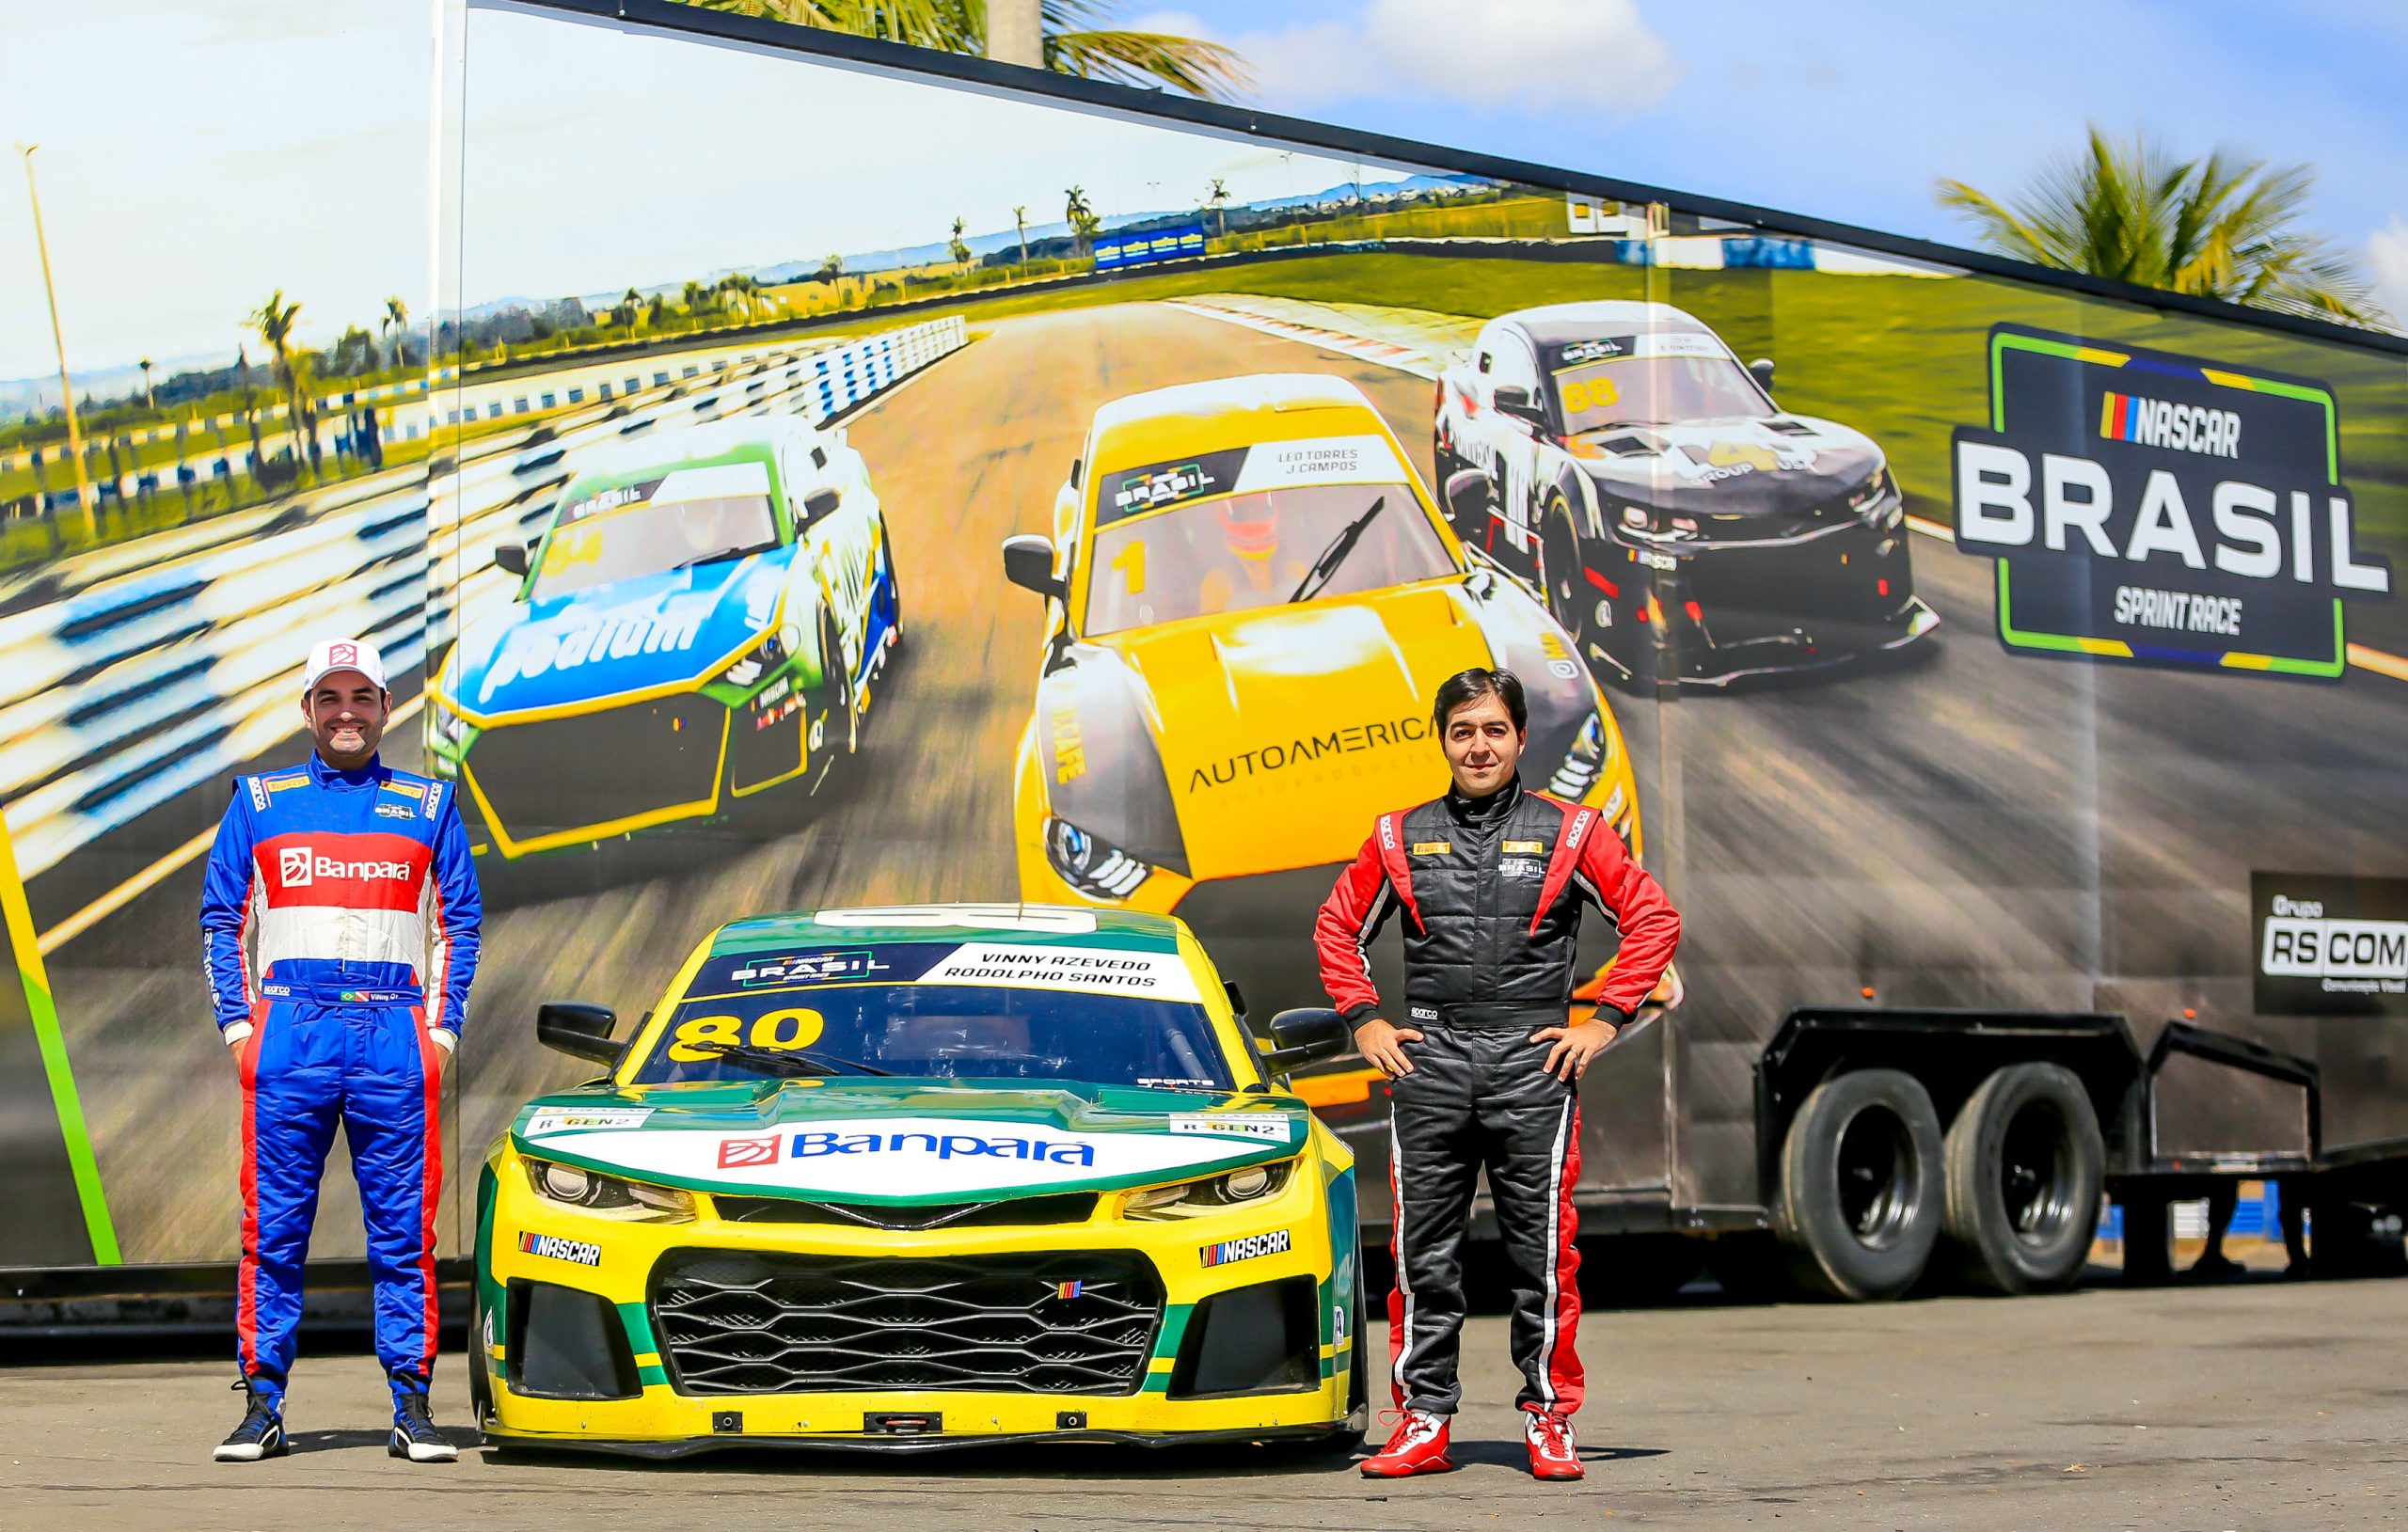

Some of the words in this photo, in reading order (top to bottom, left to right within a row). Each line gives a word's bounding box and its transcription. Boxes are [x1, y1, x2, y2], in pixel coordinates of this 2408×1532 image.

[1561, 377, 1620, 414] 88
[2135, 397, 2242, 459] NASCAR
[1279, 451, 1303, 463] LEO
[1307, 450, 1358, 460] TORRES
[1300, 461, 1357, 473] CAMPOS
[1114, 471, 1216, 508] BRASIL
[1956, 440, 2389, 592] BRASIL
[1112, 542, 1145, 594] 1
[2115, 585, 2190, 630] SPRINT
[2188, 594, 2243, 636] RACE
[425, 782, 444, 822] sparco
[1380, 814, 1396, 851] sparco
[1565, 810, 1592, 850] sparco
[315, 857, 411, 882] Banpará
[1498, 863, 1546, 875] BRASIL
[731, 959, 891, 981] BRASIL
[943, 967, 1064, 981] RODOLPHO
[1069, 972, 1158, 987] SANTOS
[982, 953, 1048, 965] VINNY
[1051, 956, 1151, 971] AZEVEDO
[1411, 1006, 1438, 1020] sparco
[668, 1006, 825, 1063] 80
[791, 1131, 1095, 1167] Banpará
[536, 1235, 601, 1266] NASCAR
[1223, 1229, 1290, 1263] NASCAR
